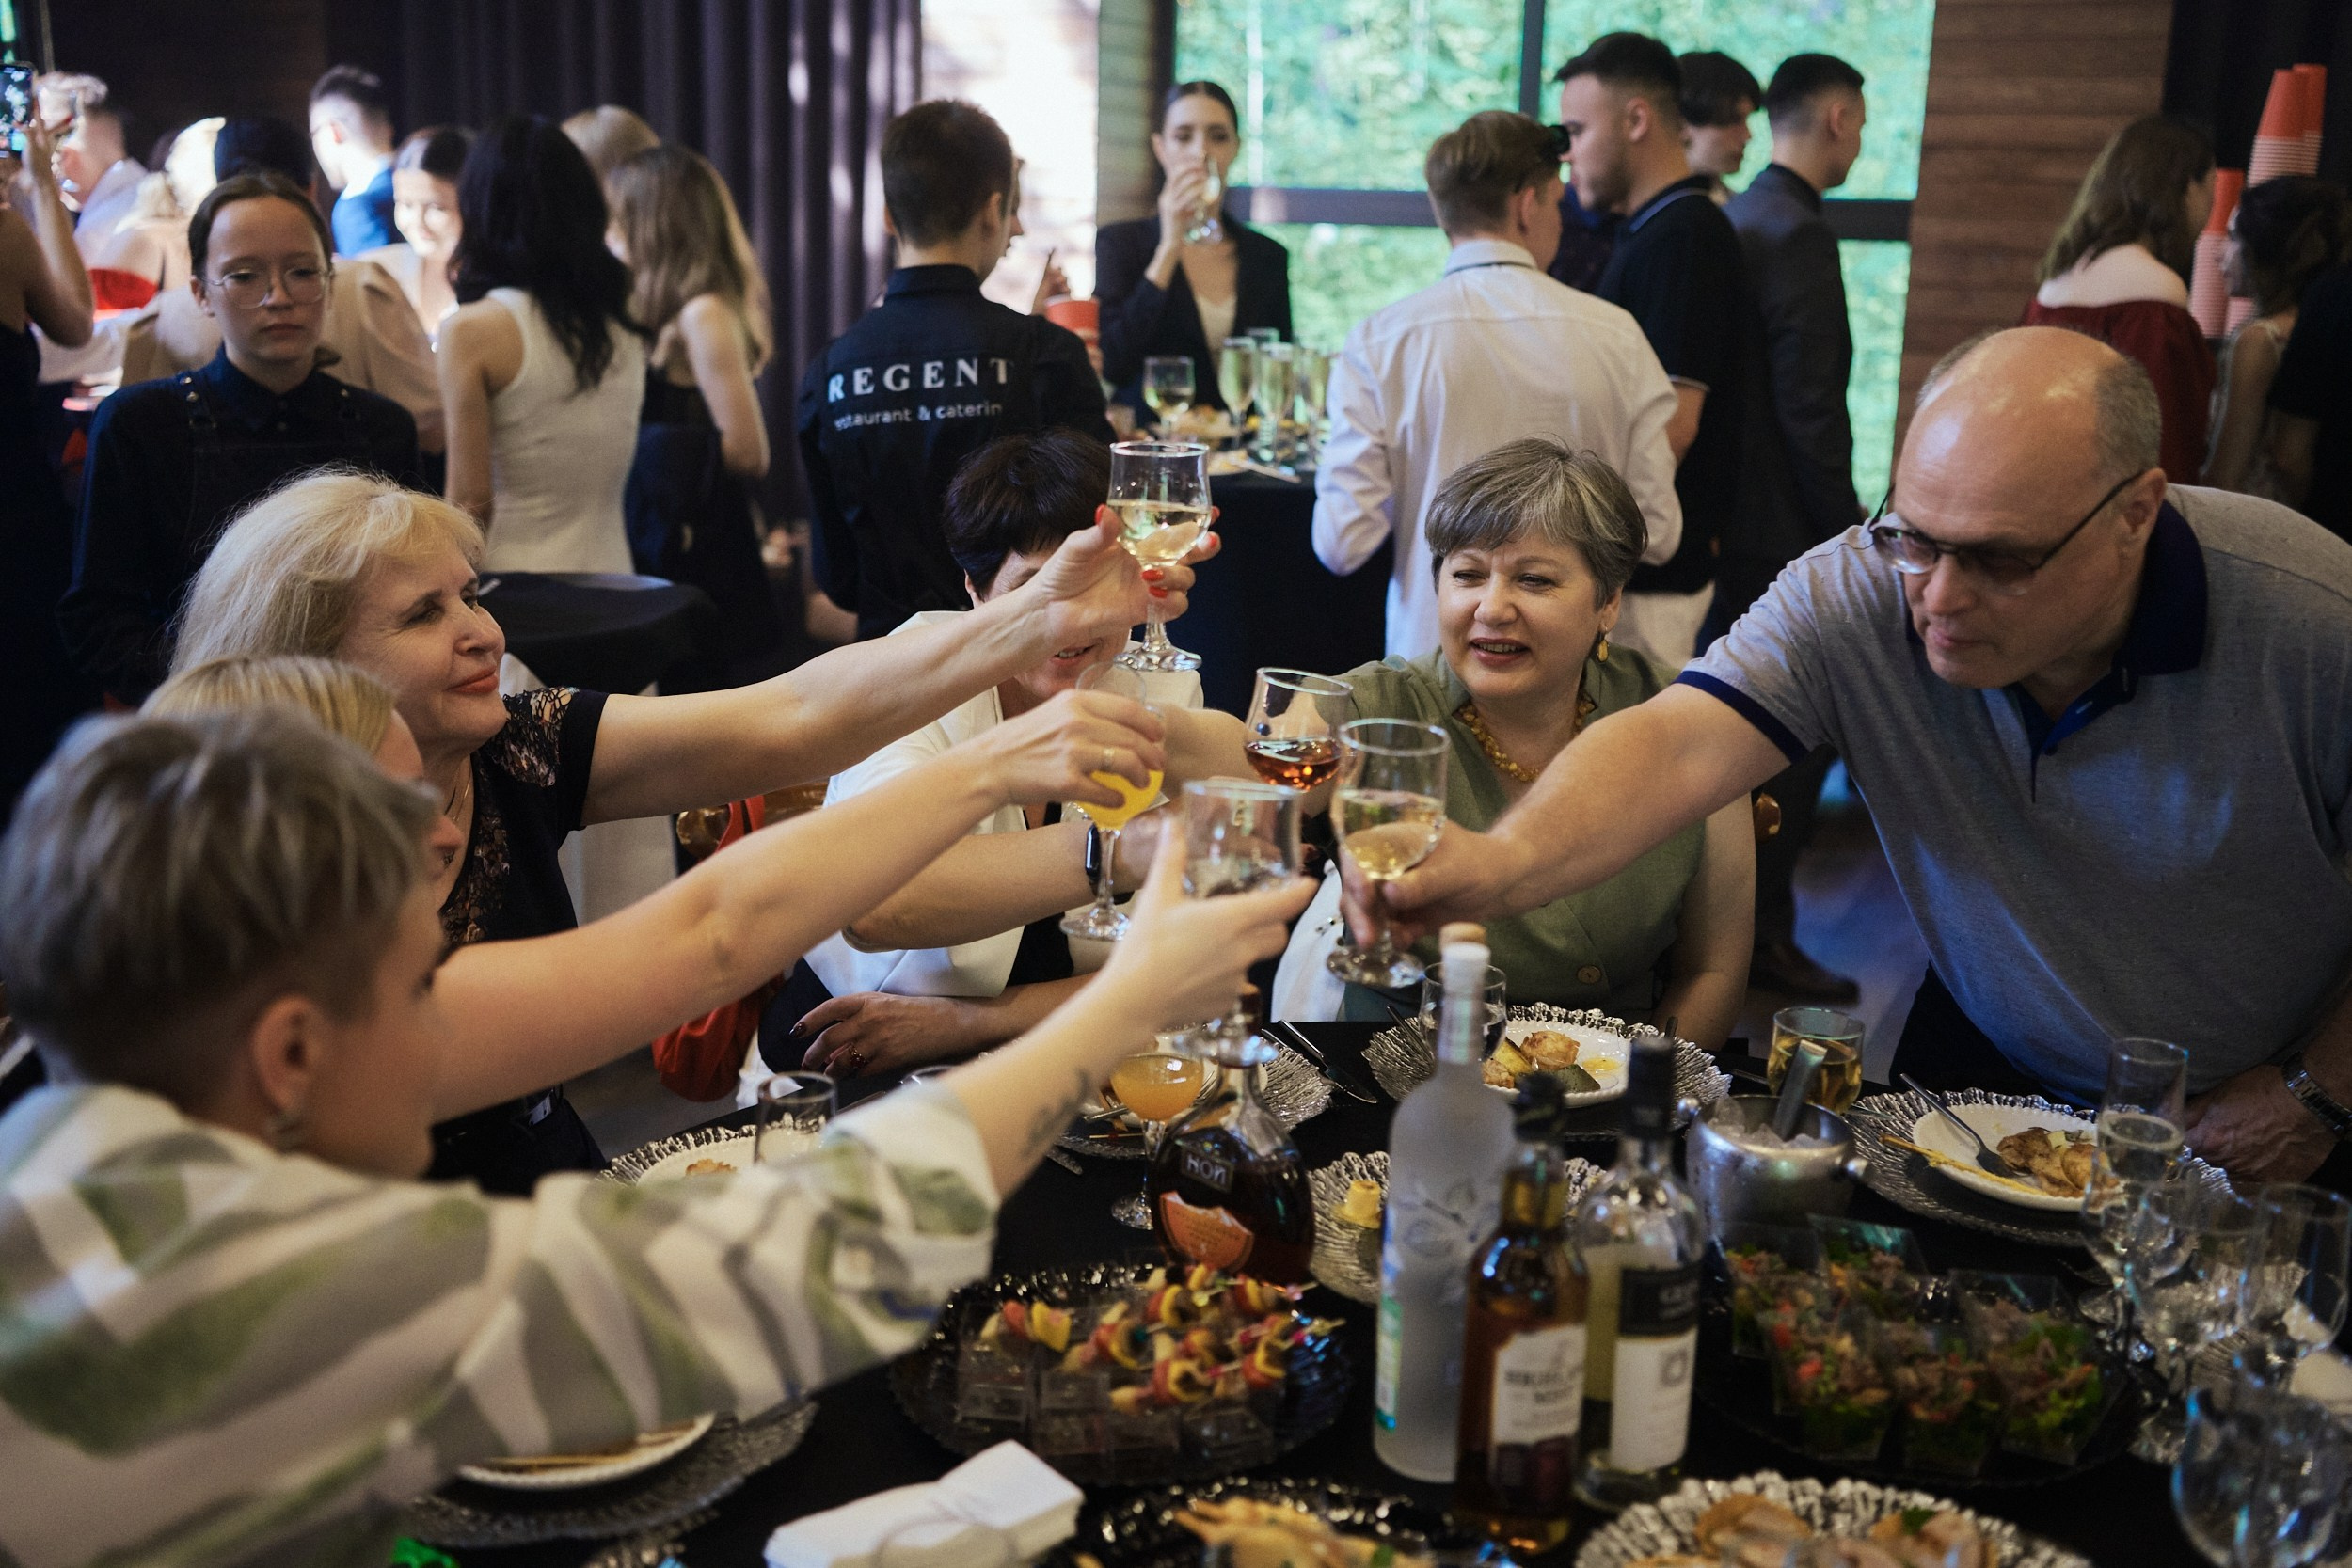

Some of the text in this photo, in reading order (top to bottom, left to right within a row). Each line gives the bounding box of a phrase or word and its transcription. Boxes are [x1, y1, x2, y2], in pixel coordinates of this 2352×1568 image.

[828, 357, 1012, 403] REGENT
[917, 405, 931, 421] &
[935, 401, 1003, 420] caterin
